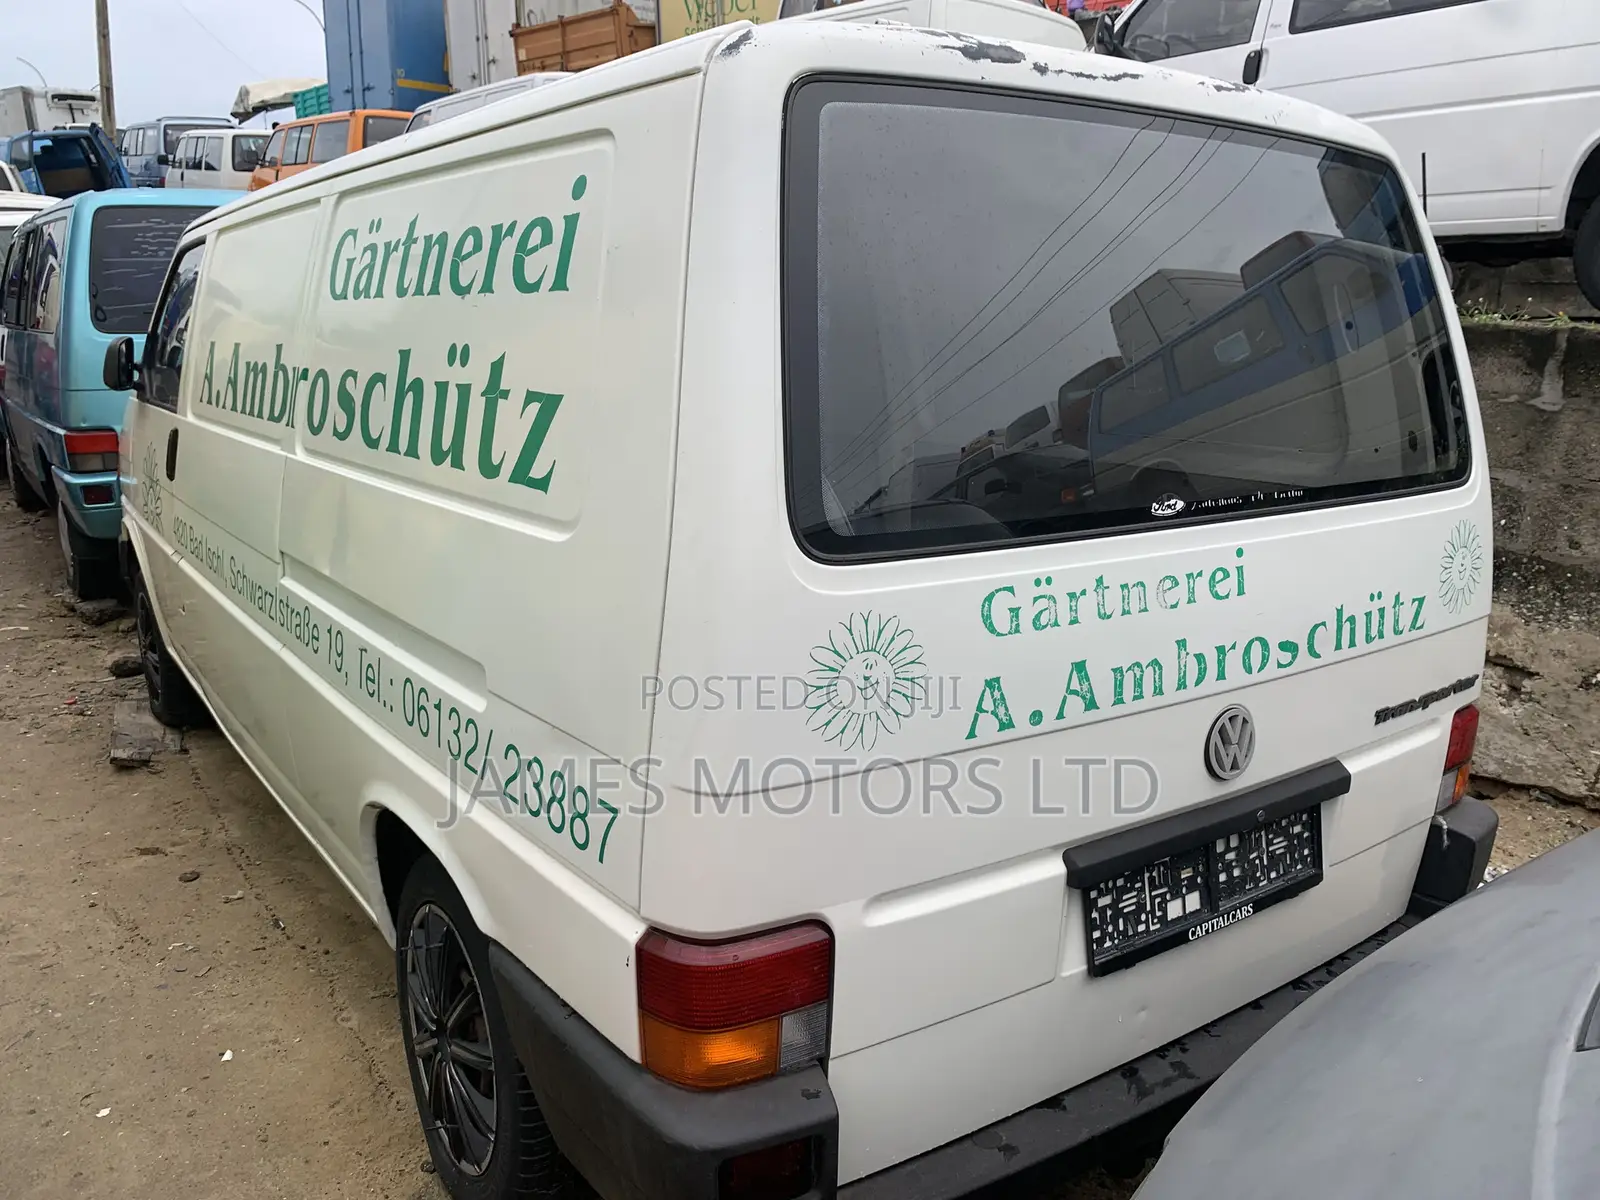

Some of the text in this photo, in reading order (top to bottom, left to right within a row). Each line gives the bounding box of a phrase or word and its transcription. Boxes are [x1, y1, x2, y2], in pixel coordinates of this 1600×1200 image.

[329, 174, 589, 301] Gärtnerei
[980, 547, 1247, 638] Gärtnerei
[189, 525, 203, 562] Bad
[205, 536, 228, 588] Ischl,
[229, 555, 320, 654] Schwarzlstraße
[327, 624, 348, 686] 19,
[359, 647, 393, 713] Tel.:
[403, 677, 493, 781] 06132/
[503, 743, 619, 864] 23887
[1188, 903, 1254, 941] CAPITALCARS
